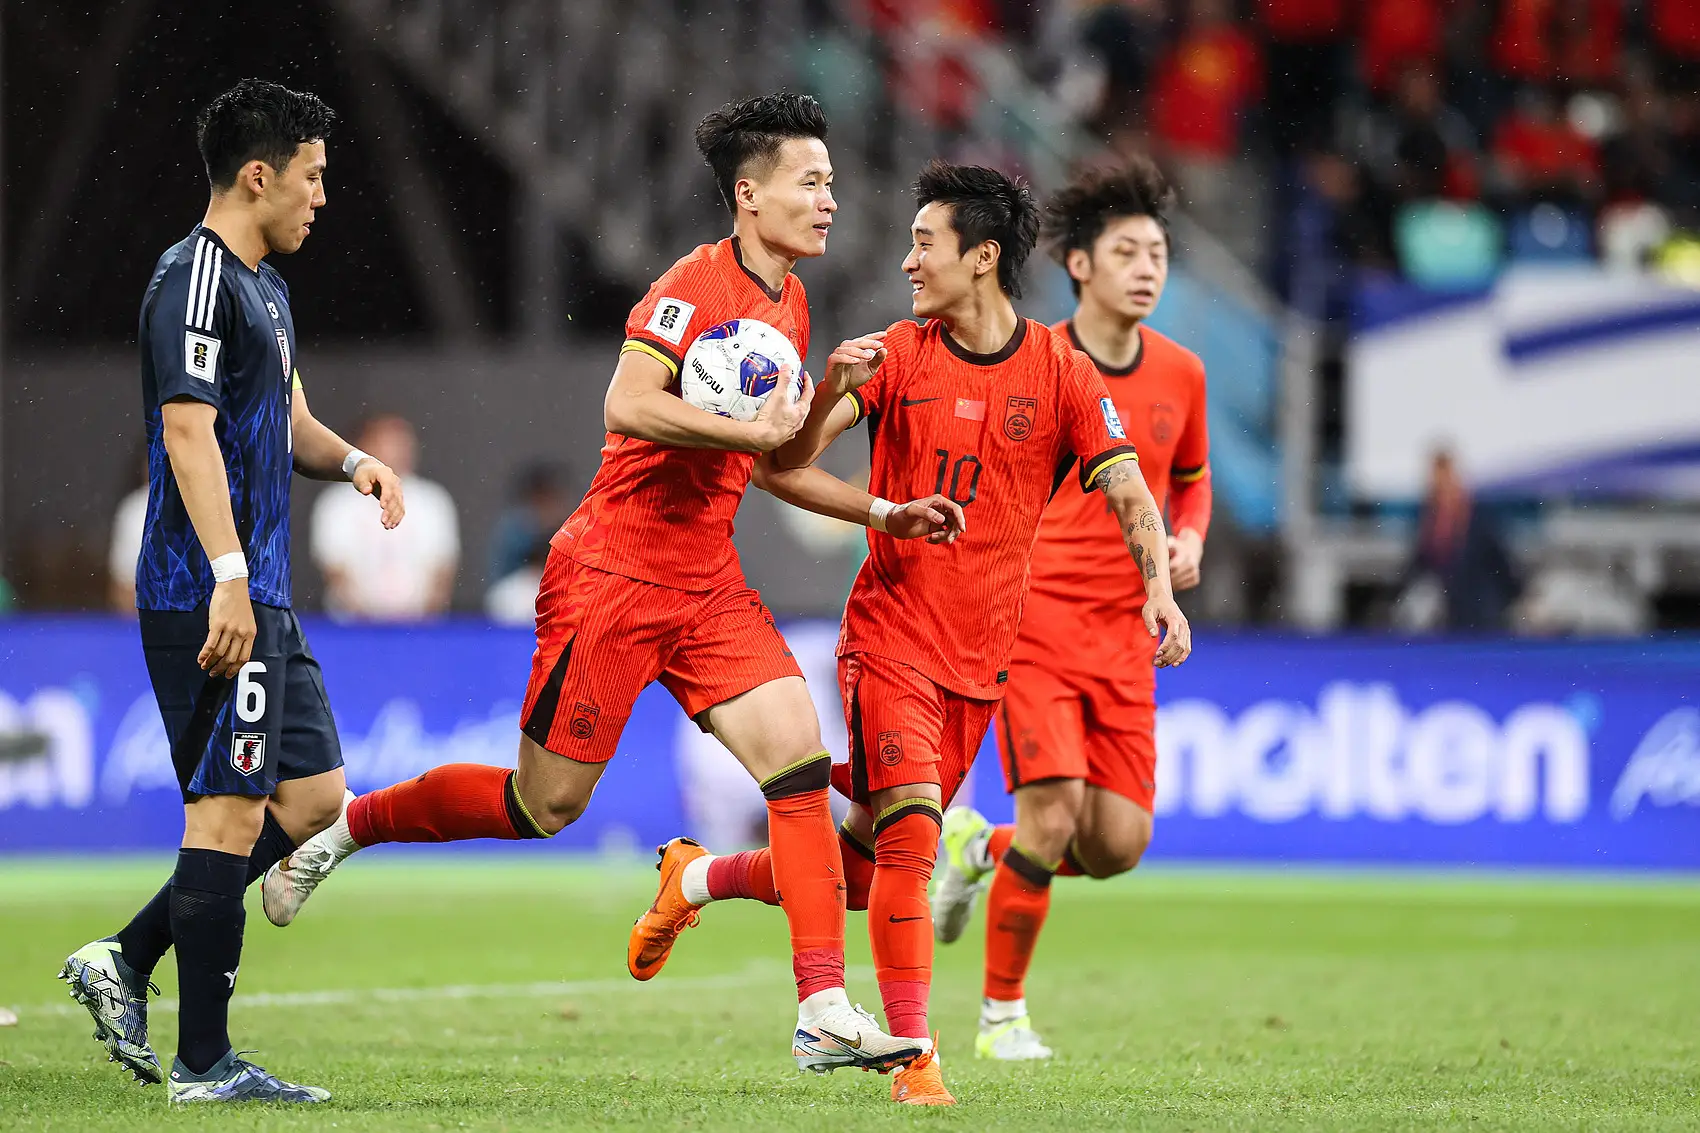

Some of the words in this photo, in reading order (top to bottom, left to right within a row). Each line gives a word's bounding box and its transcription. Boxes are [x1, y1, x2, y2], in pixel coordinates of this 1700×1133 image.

[691, 357, 724, 395] molten
[1009, 399, 1035, 409] CFA
[934, 448, 983, 508] 10
[236, 661, 267, 723] 6
[879, 732, 900, 741] CFA
